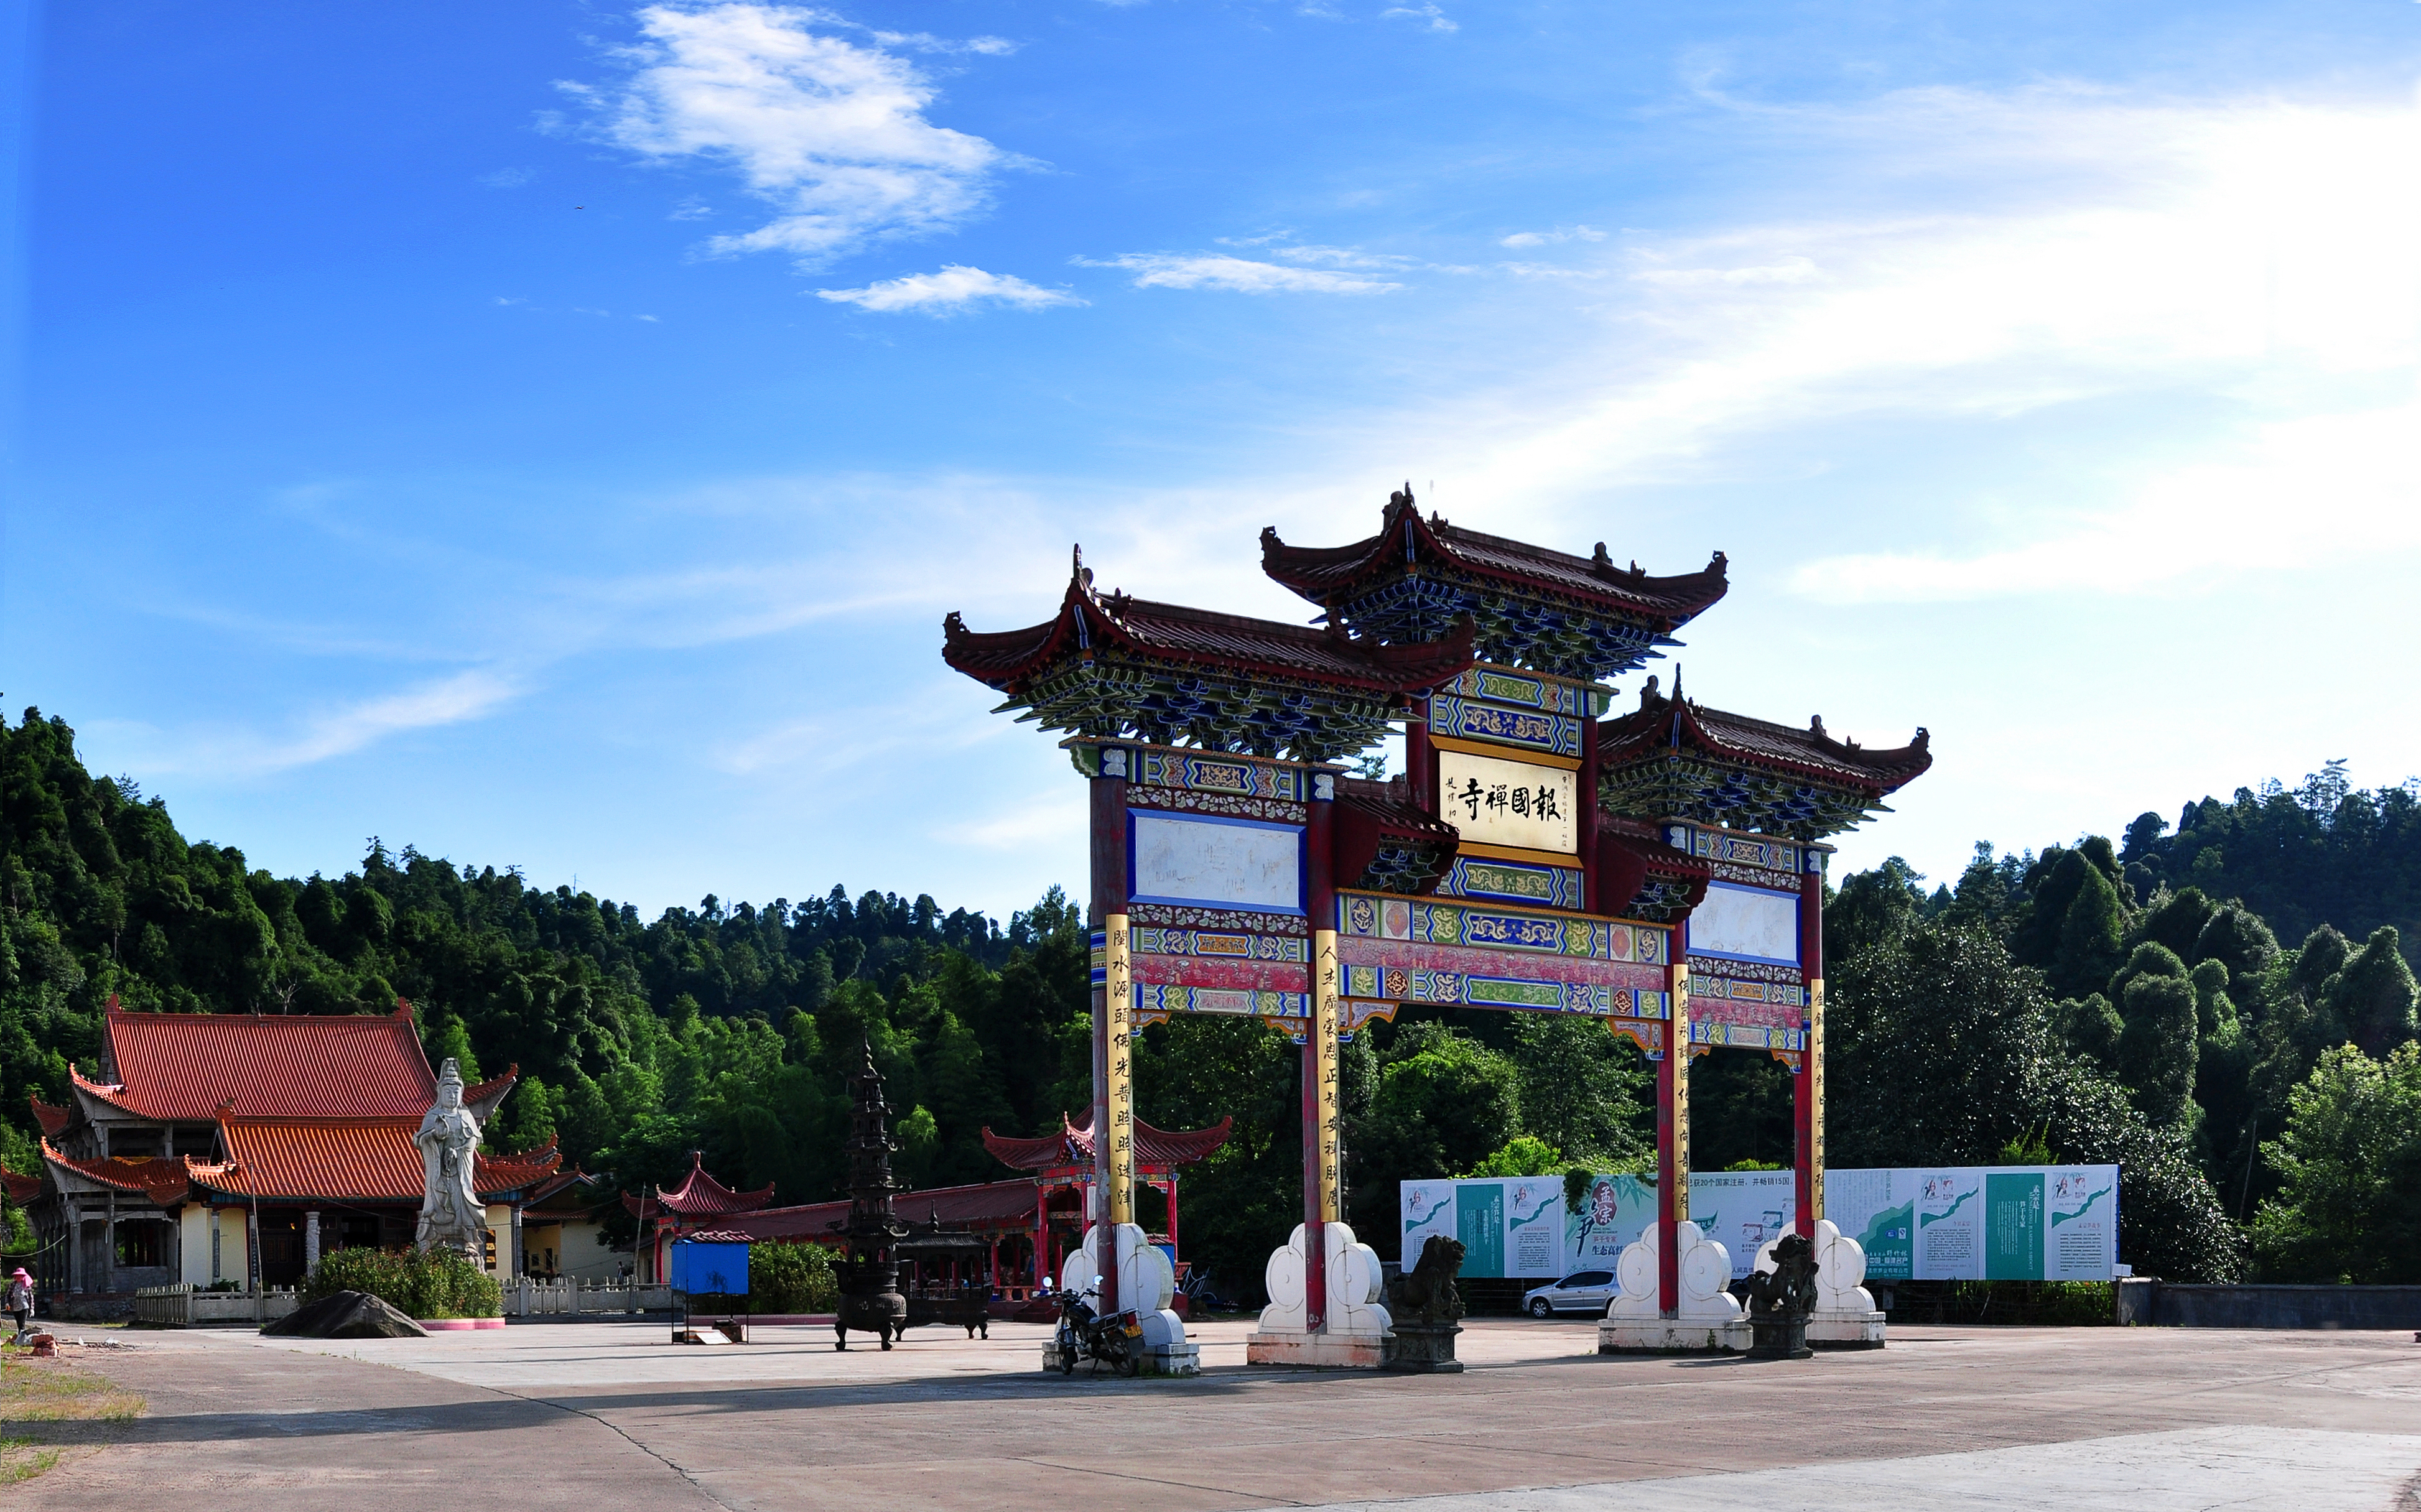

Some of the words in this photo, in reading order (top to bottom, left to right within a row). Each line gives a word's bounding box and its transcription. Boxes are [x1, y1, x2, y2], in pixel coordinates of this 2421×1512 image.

[1458, 777, 1561, 822] 報國禪寺
[1599, 1185, 1613, 1223] 孟宗
